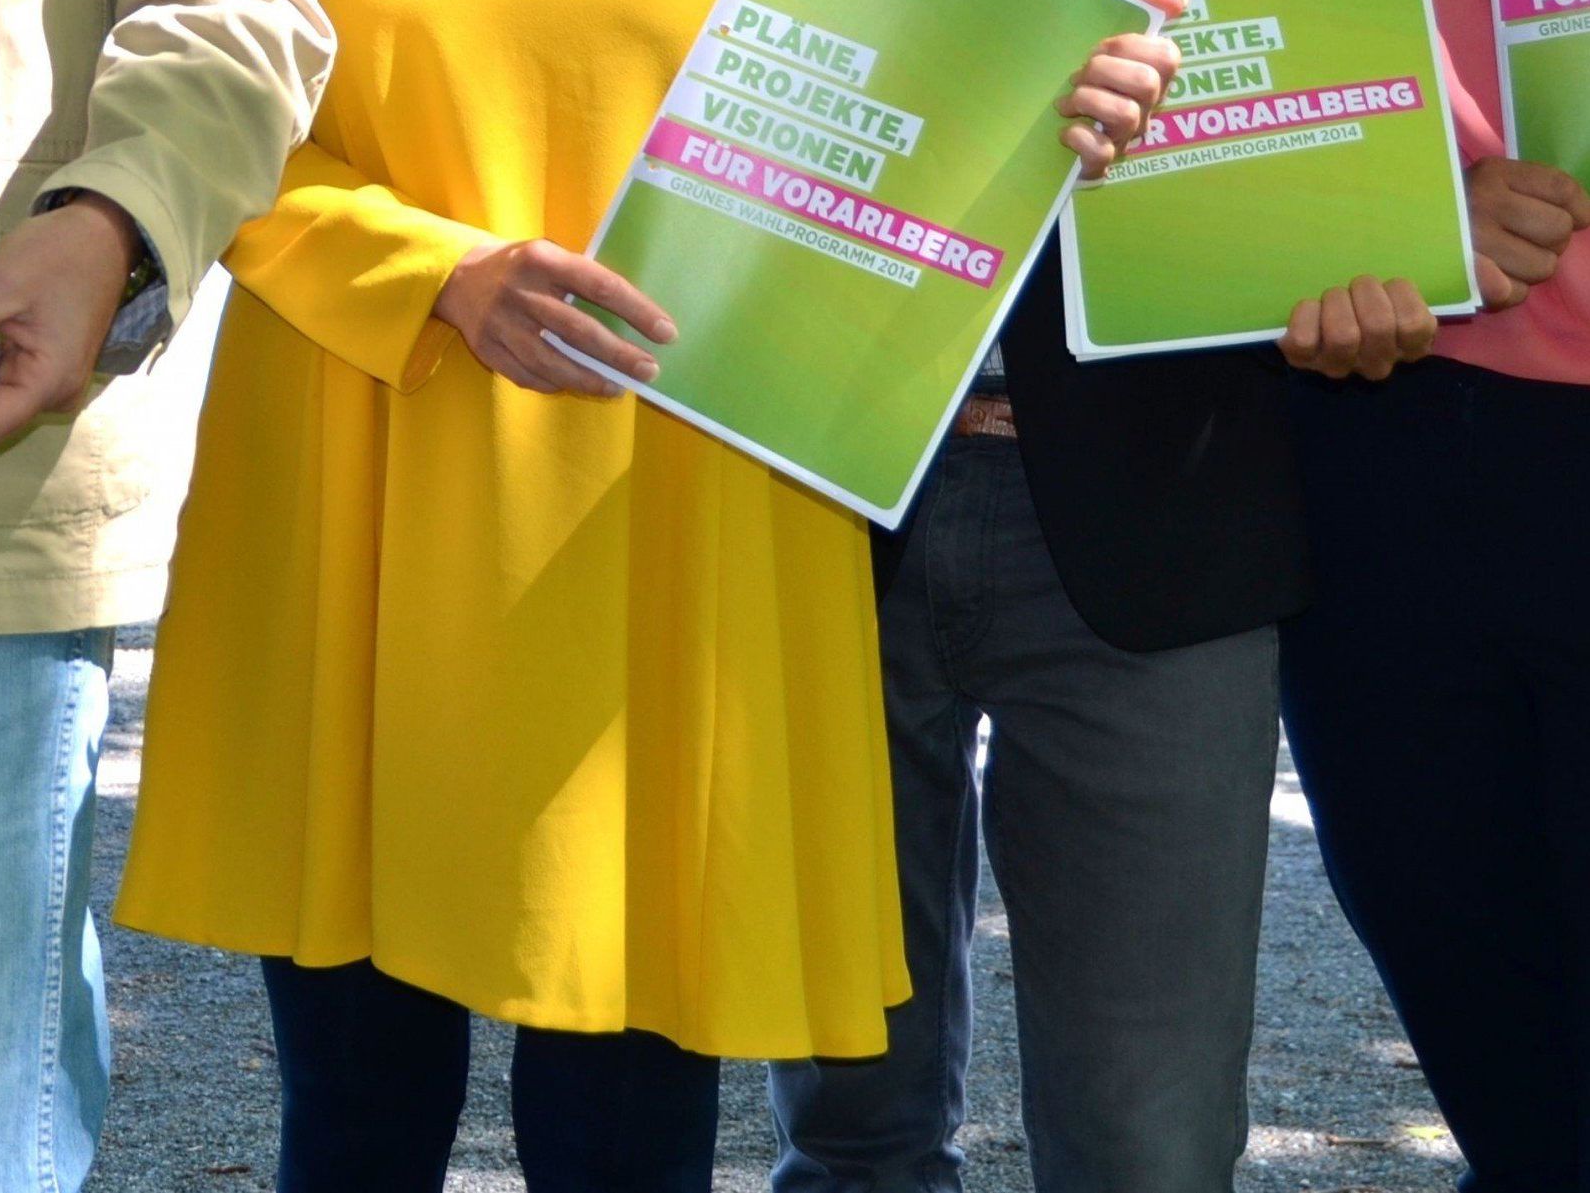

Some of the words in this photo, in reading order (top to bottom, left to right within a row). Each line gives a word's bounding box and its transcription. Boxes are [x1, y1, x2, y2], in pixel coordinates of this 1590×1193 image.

[732, 6, 862, 82] PLÄNE,
[1180, 24, 1276, 56] EKTE,
[715, 49, 908, 151] PROJEKTE,
[1168, 62, 1264, 99] ONEN
[1174, 82, 1416, 139] VORARLBERG
[704, 92, 877, 184] VISIONEN
[1105, 158, 1170, 181] GRÜNES
[1173, 131, 1317, 167] WAHLPROGRAMM
[1321, 124, 1359, 142] 2014
[670, 174, 737, 213] GRÜNES
[737, 201, 876, 269] WAHLPROGRAMM
[877, 251, 917, 285] 2014
[680, 135, 761, 188] FÜR
[762, 165, 996, 280] VORARLBERG
